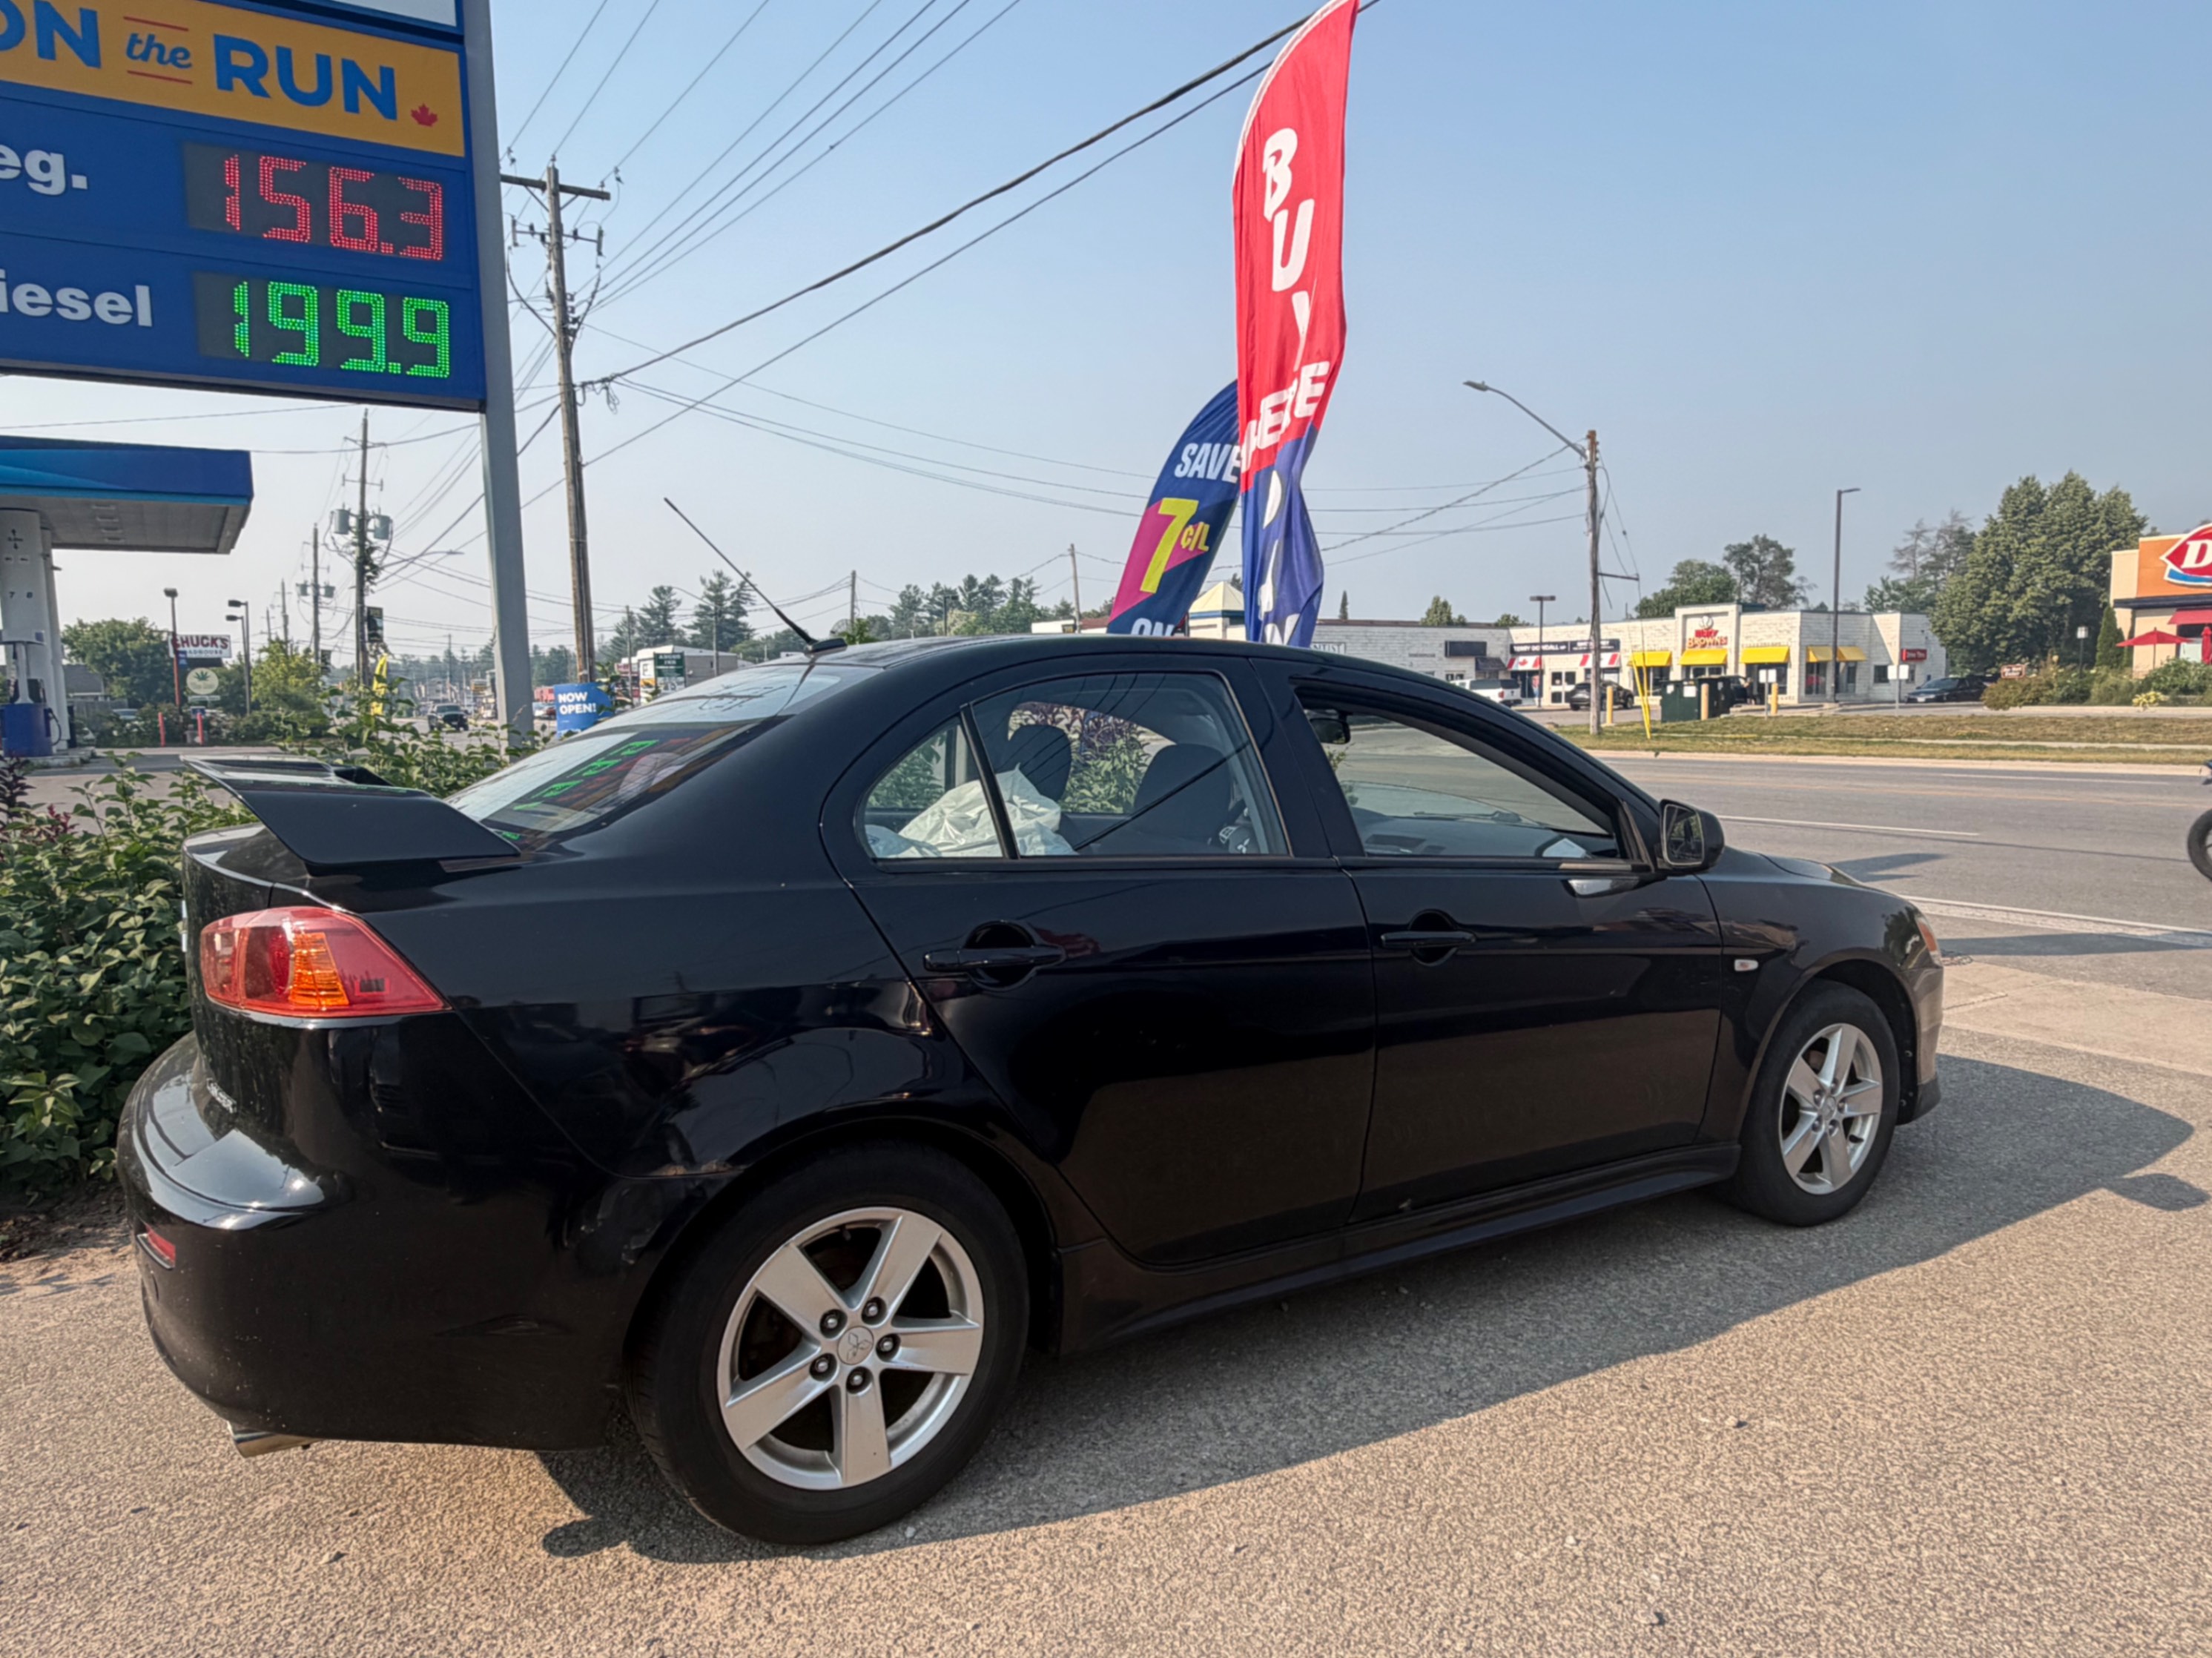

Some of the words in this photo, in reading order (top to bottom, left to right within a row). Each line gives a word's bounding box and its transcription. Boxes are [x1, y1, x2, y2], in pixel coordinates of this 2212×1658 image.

[125, 32, 193, 69] the
[214, 33, 397, 121] RUN
[224, 154, 443, 260] 156.3
[234, 281, 450, 378] 199.9
[1174, 443, 1241, 483] SAVE
[1241, 361, 1330, 473] HEE
[1140, 497, 1199, 594] 7
[558, 691, 588, 704] NOW
[559, 703, 597, 716] OPEN!
